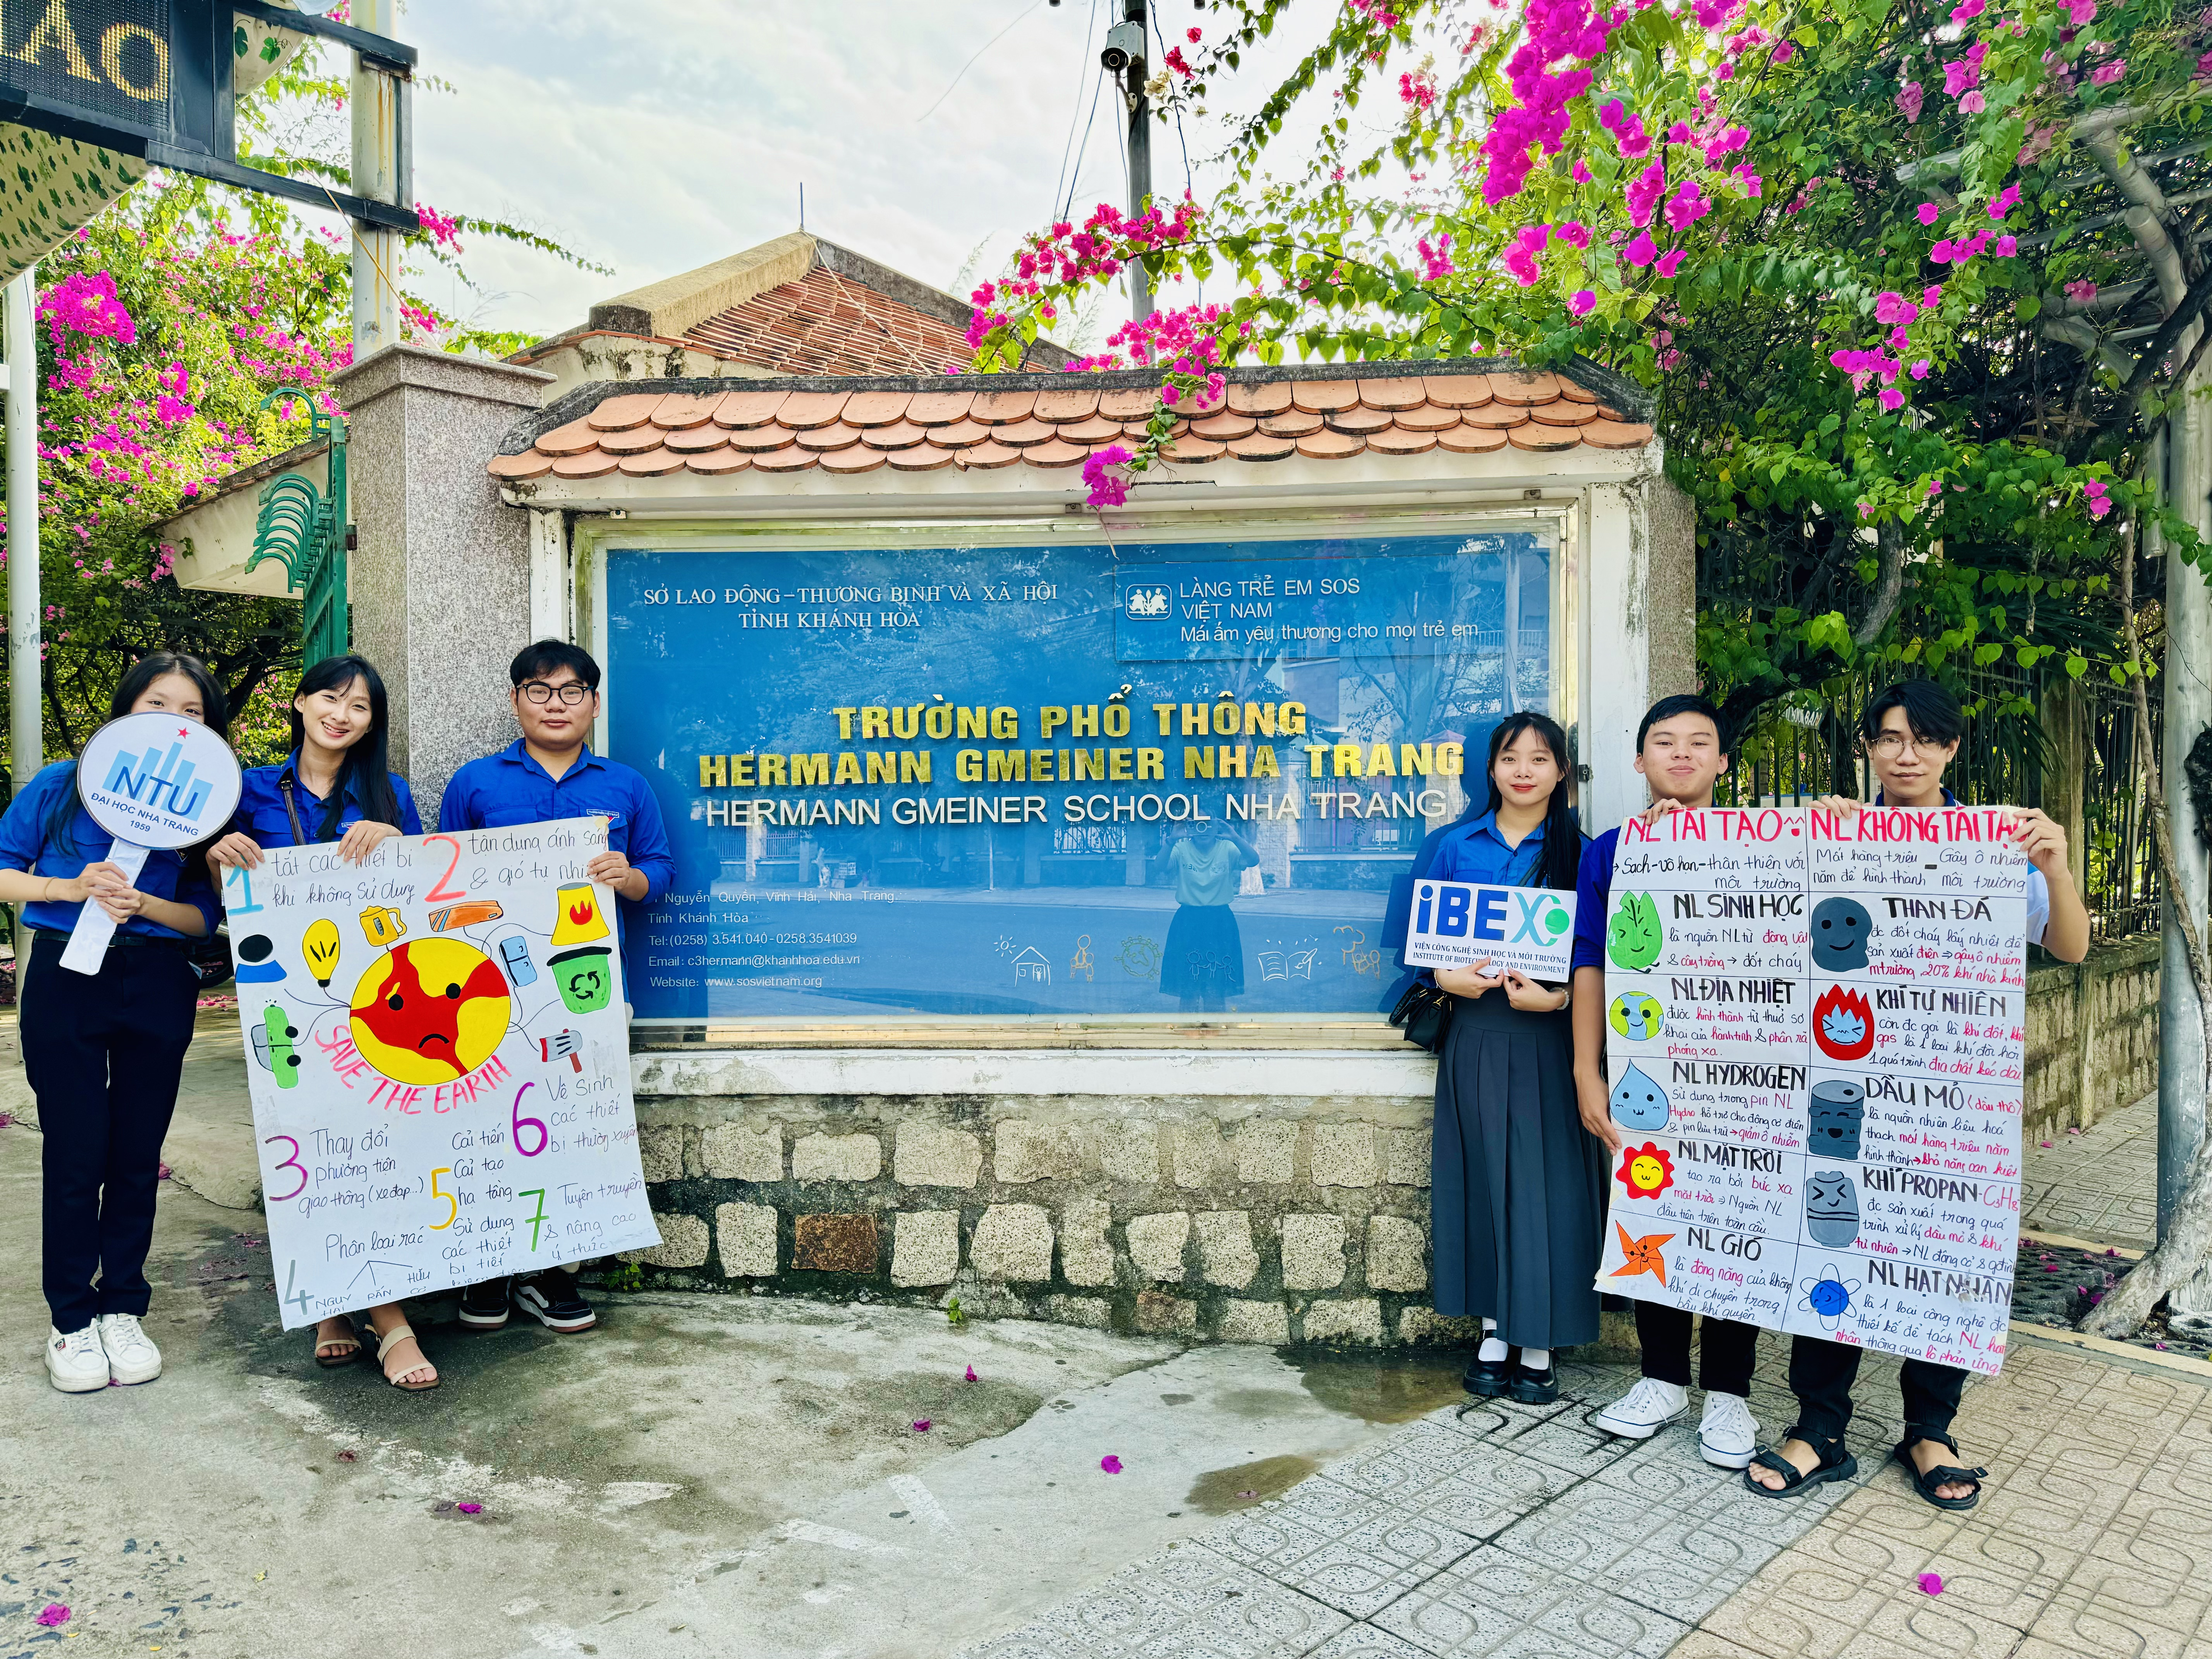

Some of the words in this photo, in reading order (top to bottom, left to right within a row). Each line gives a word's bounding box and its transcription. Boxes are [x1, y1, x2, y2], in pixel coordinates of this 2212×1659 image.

[644, 583, 669, 605] SỞ
[675, 589, 716, 604] LAO
[890, 586, 941, 602] BINH
[948, 583, 972, 601] VÀ
[982, 581, 1012, 601] XÃ
[1023, 581, 1058, 604] HỘI
[1180, 577, 1231, 598] LÀNG
[1238, 575, 1275, 596] TRẺ
[1285, 580, 1312, 595] EM
[1321, 578, 1360, 595] SOS
[738, 608, 789, 628] TỈNH
[797, 608, 872, 628] KHÁNH
[880, 607, 921, 627] HÒA
[1181, 601, 1222, 622] VIỆT
[1231, 603, 1272, 618] NAM
[1181, 626, 1209, 642] Mái
[1214, 620, 1238, 641] ấm
[1245, 625, 1274, 644] yêu
[1281, 623, 1341, 642] thương
[1348, 624, 1378, 638] cho
[1386, 623, 1415, 641] mọi
[1422, 621, 1444, 637] trẻ
[1451, 624, 1478, 637] em
[833, 694, 1018, 739] TRƯỜNG
[1041, 684, 1132, 738] PHỔ
[1153, 690, 1307, 737] THÔNG
[699, 750, 931, 787] HERMANN
[956, 748, 1164, 782] GMEINER
[1183, 745, 1281, 780] NHA
[1304, 742, 1464, 778] TRANG
[112, 766, 199, 816] NTU
[91, 793, 110, 805] ĐẠI
[112, 800, 135, 813] HỌC
[138, 809, 159, 823] NHA
[163, 818, 198, 836] TRANG
[707, 798, 880, 826] HERMANN
[892, 797, 1047, 824] GMEINER
[1064, 793, 1211, 822] SCHOOL
[1226, 792, 1300, 820] NHA
[1318, 789, 1446, 819] TRANG
[130, 820, 150, 832] 1959
[1625, 818, 1661, 845] NL
[1711, 810, 1782, 847] TẠO
[1811, 809, 1852, 841] NL
[1858, 807, 1939, 844] KHÔNG
[422, 835, 466, 902] 2
[468, 833, 497, 855] tận
[503, 833, 541, 855] dụng
[548, 827, 575, 847] ánh
[471, 868, 488, 889] &
[499, 860, 524, 886] gió
[226, 852, 264, 916] 1
[271, 851, 299, 876] tắt
[310, 848, 340, 872] các
[397, 843, 412, 870] bị
[273, 883, 295, 907] khi
[306, 883, 351, 906] không
[665, 890, 710, 905] Nguyễn
[718, 890, 759, 905] Quyền,
[766, 891, 790, 902] Vĩnh
[830, 891, 852, 901] Nha
[1674, 894, 1704, 919] NL
[1760, 894, 1804, 921] HỌC
[647, 913, 672, 924] Tỉnh
[679, 912, 716, 923] Khánh
[725, 913, 748, 923] Hòa
[1882, 897, 1946, 920] THAN
[1950, 896, 1992, 922] ĐÁ
[1669, 927, 1680, 942] là
[1685, 929, 1718, 946] nguồn
[1723, 929, 1740, 942] NL
[687, 955, 860, 968] c3hermann@khanhhoa.edu.vn
[1413, 951, 1444, 961] INSTITUTE
[1520, 963, 1565, 973] ENVIRONMENT
[1415, 942, 1430, 951] VIỆN
[1432, 943, 1450, 952] CÔNG
[1452, 946, 1471, 955] NGHỆ
[1508, 950, 1516, 958] VÀ
[1518, 952, 1532, 960] MÔI
[1535, 953, 1566, 963] TRƯỜNG
[650, 977, 699, 987] Website:
[705, 977, 822, 988] www.sosvietnam.org
[1671, 977, 1698, 1000] NL
[1877, 1034, 1896, 1048] gas
[315, 1025, 372, 1089] SAVE
[368, 1077, 426, 1114] THE
[434, 1055, 512, 1113] EARTH
[1673, 1061, 1701, 1084] NL
[1706, 1064, 1806, 1090] HYDROGEN
[551, 1105, 577, 1125] các
[586, 1094, 620, 1120] thiết
[1924, 1082, 1964, 1111] MỎ
[513, 1082, 547, 1157] 6
[452, 1130, 473, 1150] Cải
[480, 1123, 503, 1145] tiến
[265, 1135, 307, 1201] 3
[310, 1128, 353, 1160] Thay
[362, 1124, 388, 1151] đổi
[1678, 1140, 1701, 1162] NL
[373, 1157, 395, 1175] tiện
[299, 1195, 327, 1218] giao
[331, 1190, 364, 1208] thông
[429, 1168, 457, 1230] 5
[482, 1158, 503, 1175] tạo
[519, 1188, 550, 1252] 7
[557, 1183, 592, 1208] Tuyên
[567, 1220, 603, 1237] nâng
[612, 1214, 636, 1225] cao
[1688, 1227, 1715, 1252] NL
[284, 1259, 314, 1315] 4
[326, 1234, 364, 1262] Phân
[371, 1231, 395, 1255] loại
[398, 1226, 424, 1247] rác
[1869, 1260, 1899, 1287] NL
[1905, 1266, 1942, 1297] HẠT
[316, 1294, 351, 1309] NGUY
